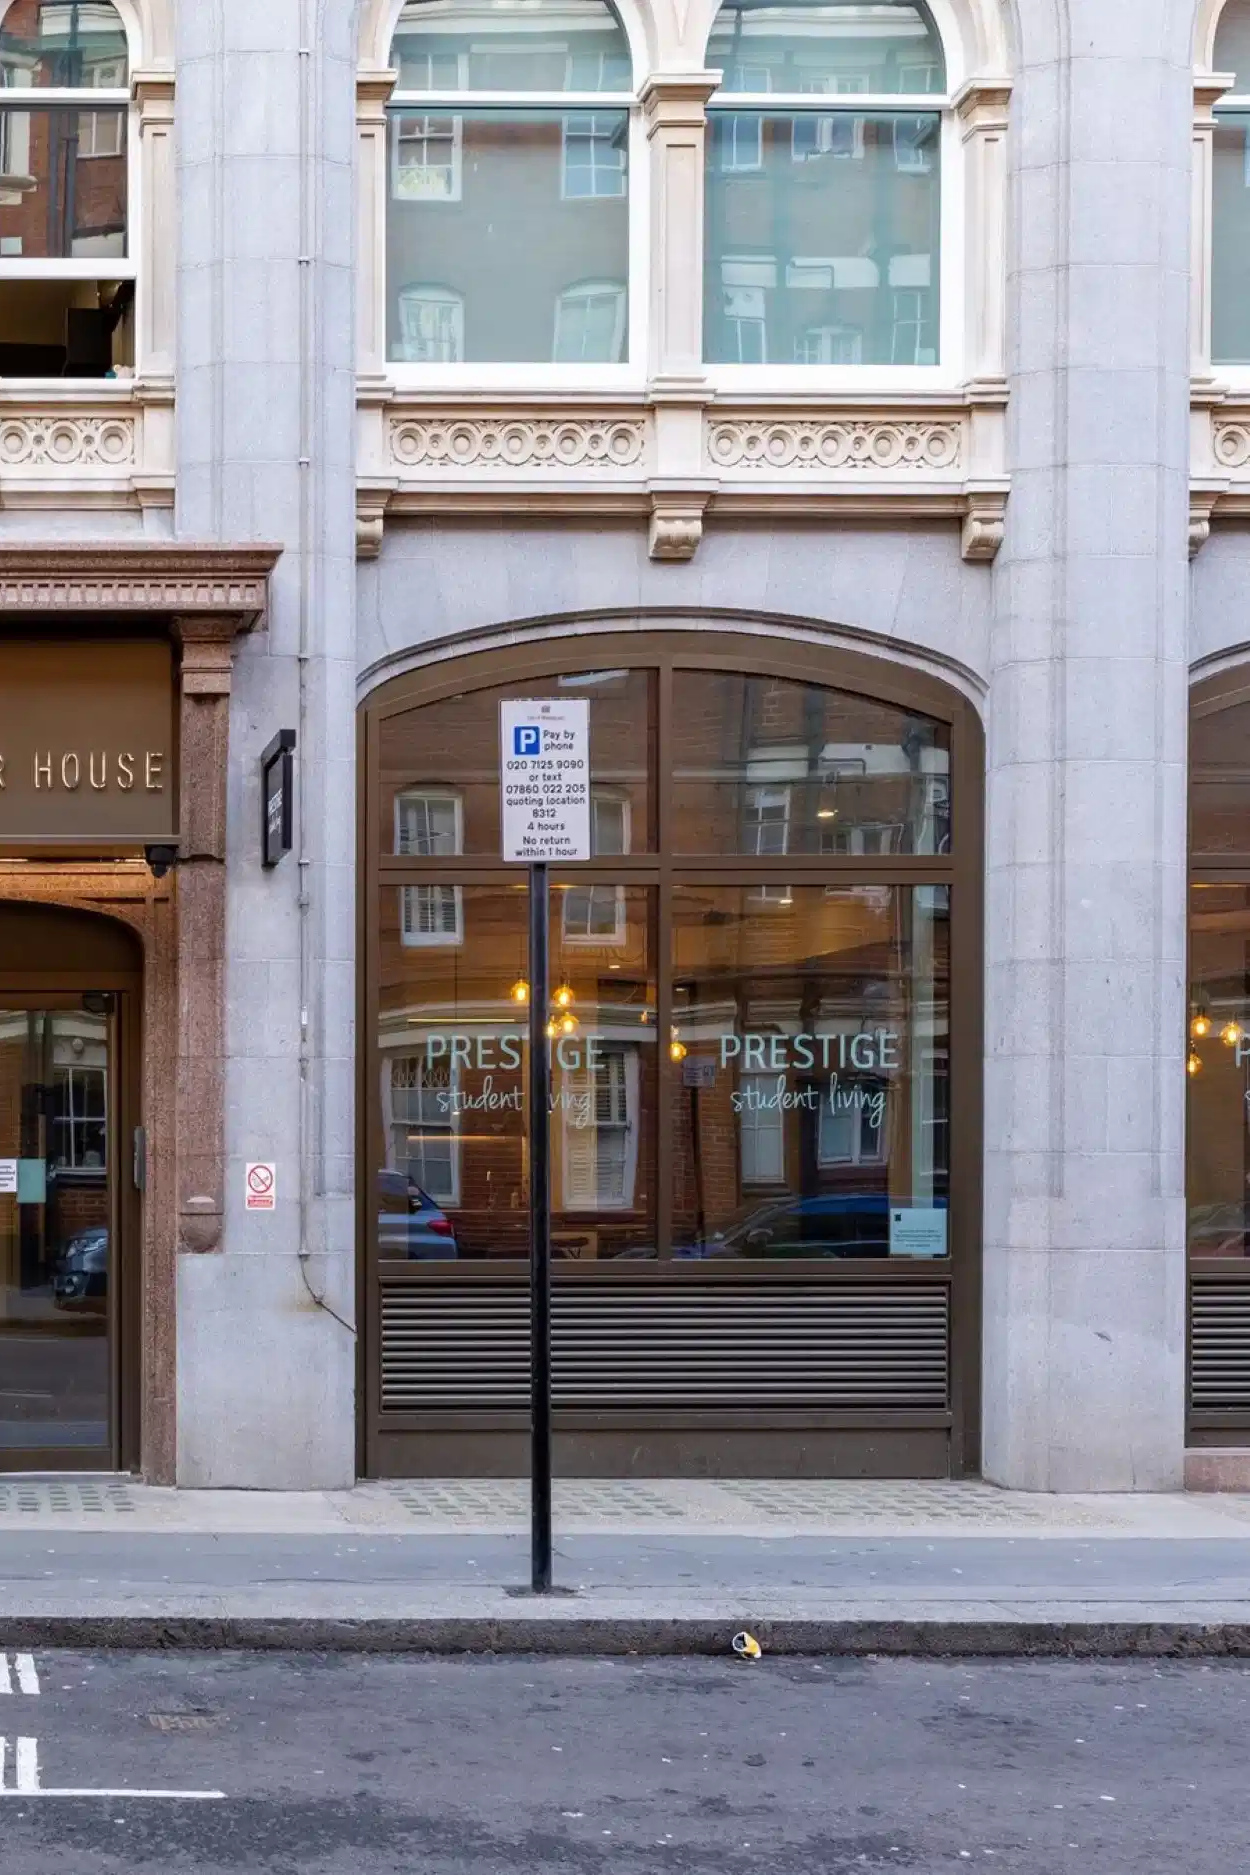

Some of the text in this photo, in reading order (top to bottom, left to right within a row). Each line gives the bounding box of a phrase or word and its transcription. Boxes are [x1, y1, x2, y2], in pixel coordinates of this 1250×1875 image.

[543, 729, 576, 740] Pay by
[520, 729, 537, 753] P
[543, 741, 574, 751] phone
[33, 751, 164, 789] HOUSE
[506, 759, 584, 770] 020 7125 9090
[542, 773, 562, 781] text
[506, 783, 586, 794] 07860 022 205
[506, 795, 586, 807] quoting location
[527, 822, 565, 830] 4 hours
[522, 836, 571, 845] No return
[515, 847, 545, 856] within
[555, 847, 578, 856] hour
[720, 1033, 899, 1070] PRESTIGE
[435, 1075, 592, 1130] student ving
[729, 1074, 820, 1114] student
[828, 1071, 887, 1129] living
